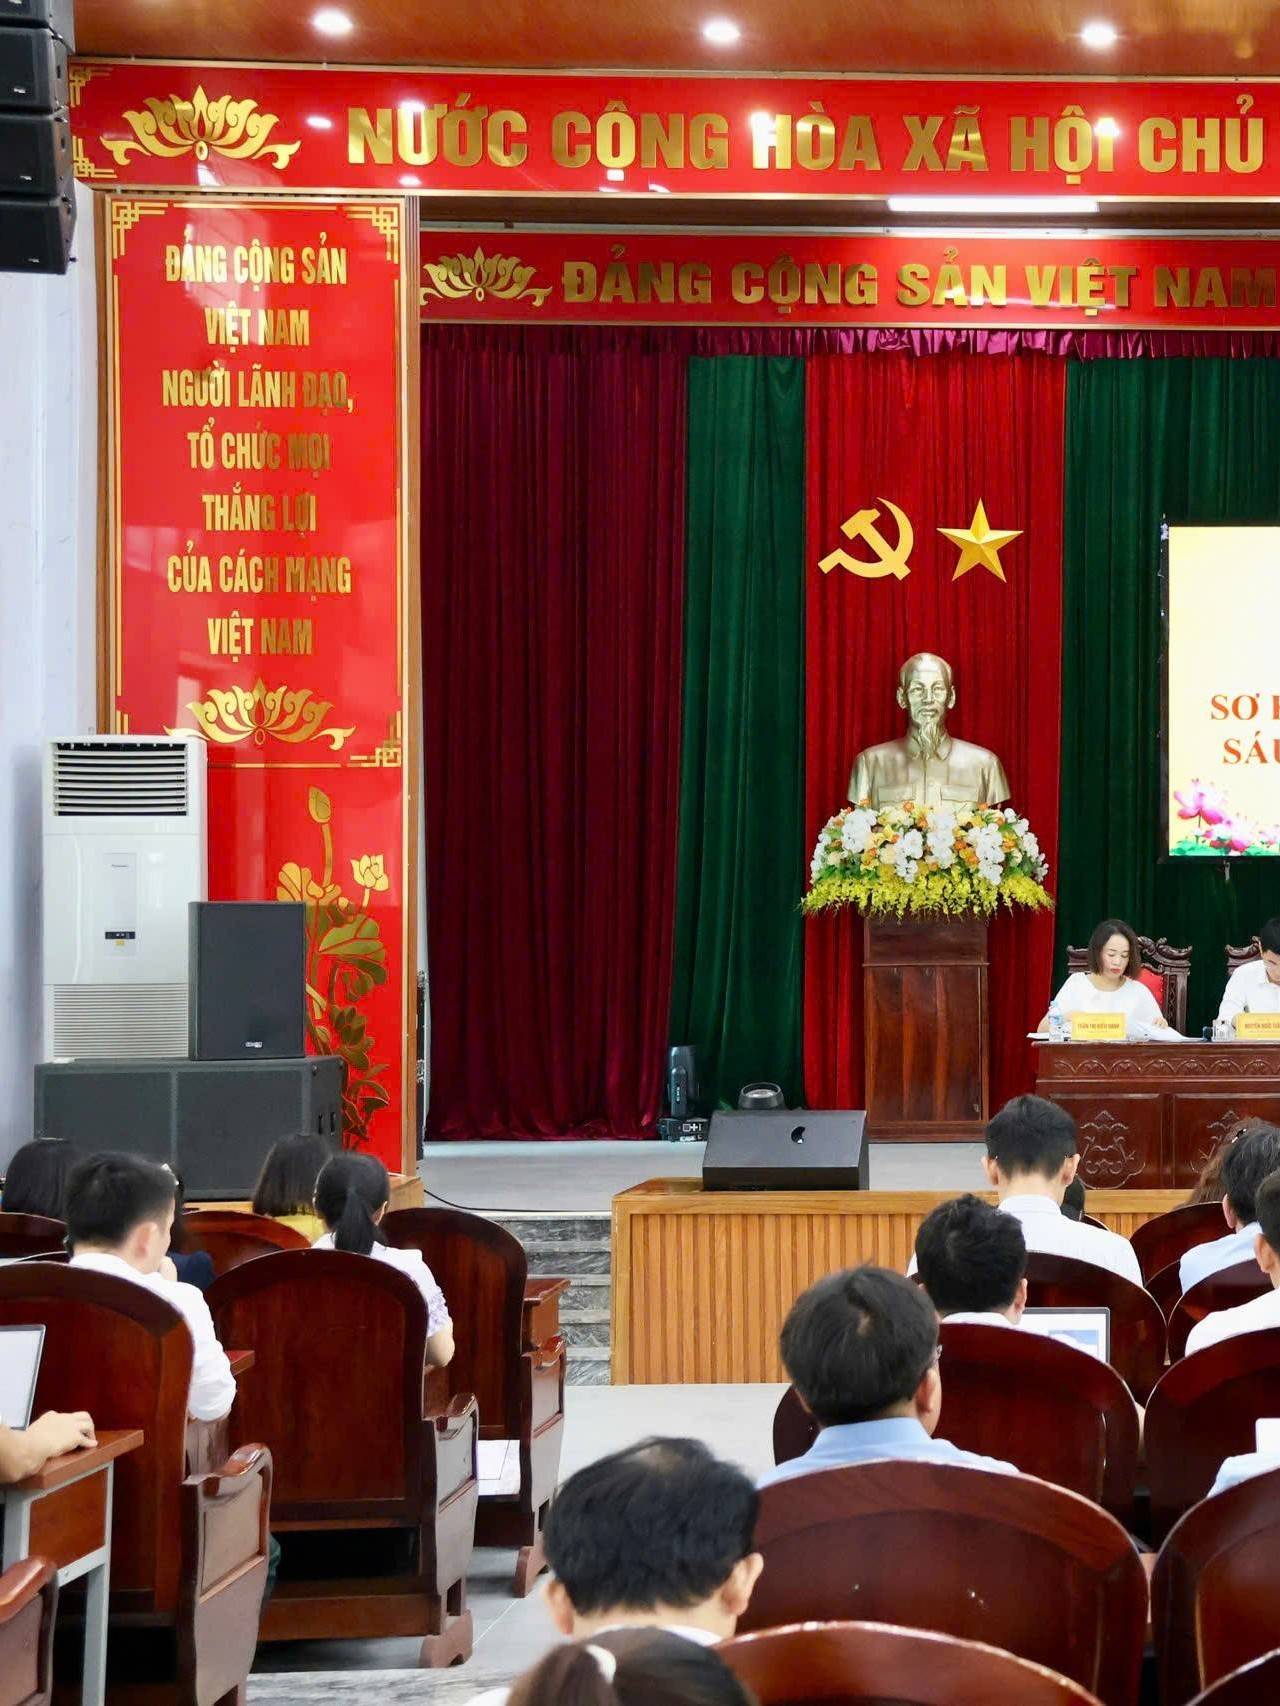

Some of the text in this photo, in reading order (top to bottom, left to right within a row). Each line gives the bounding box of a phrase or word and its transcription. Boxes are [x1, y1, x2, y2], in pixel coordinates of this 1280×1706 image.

[347, 92, 529, 168] NƯỚC
[551, 100, 729, 181] CỘNG
[752, 101, 882, 171] HÒA
[903, 105, 989, 172] XÃ
[1009, 105, 1114, 184] HỘI
[1138, 94, 1264, 174] CHỦ
[165, 223, 347, 292] ĐẢNG CỘNG SẢN
[561, 245, 712, 305] ĐẢNG
[731, 257, 878, 314] CỘNG
[897, 247, 1007, 307] SẢN
[1026, 257, 1137, 316] VIỆT
[1153, 266, 1277, 308] NAM
[204, 300, 310, 353] VIỆT NAM
[162, 360, 354, 416] NGƯỜI LÃNH ĐẠO,
[187, 417, 330, 478] TỔ CHỨC MỌI
[202, 481, 316, 538] THẮNG LỢI
[167, 540, 351, 601] CỦA CÁCH MẠNG
[207, 610, 313, 663] VIỆT NAM
[1210, 692, 1260, 720] SƠ
